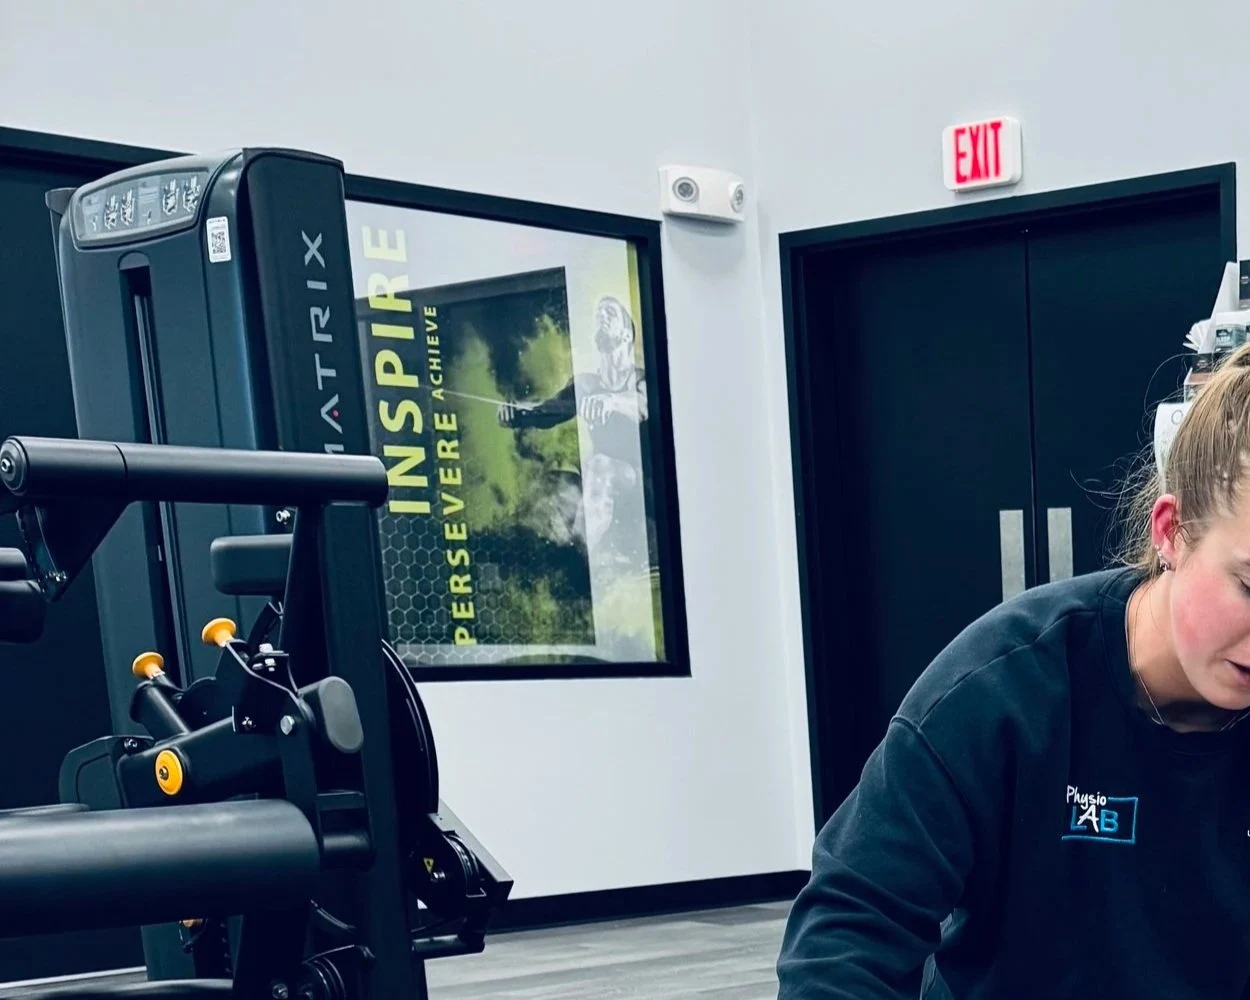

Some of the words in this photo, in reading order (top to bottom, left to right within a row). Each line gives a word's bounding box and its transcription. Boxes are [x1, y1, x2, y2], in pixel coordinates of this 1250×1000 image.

[954, 120, 1002, 184] EXIT
[361, 225, 432, 514] INSPIRE
[424, 305, 445, 401] ACHIEVE
[434, 412, 478, 646] PERSEVERE
[1066, 784, 1107, 810] Physio
[1070, 804, 1119, 833] LAB
